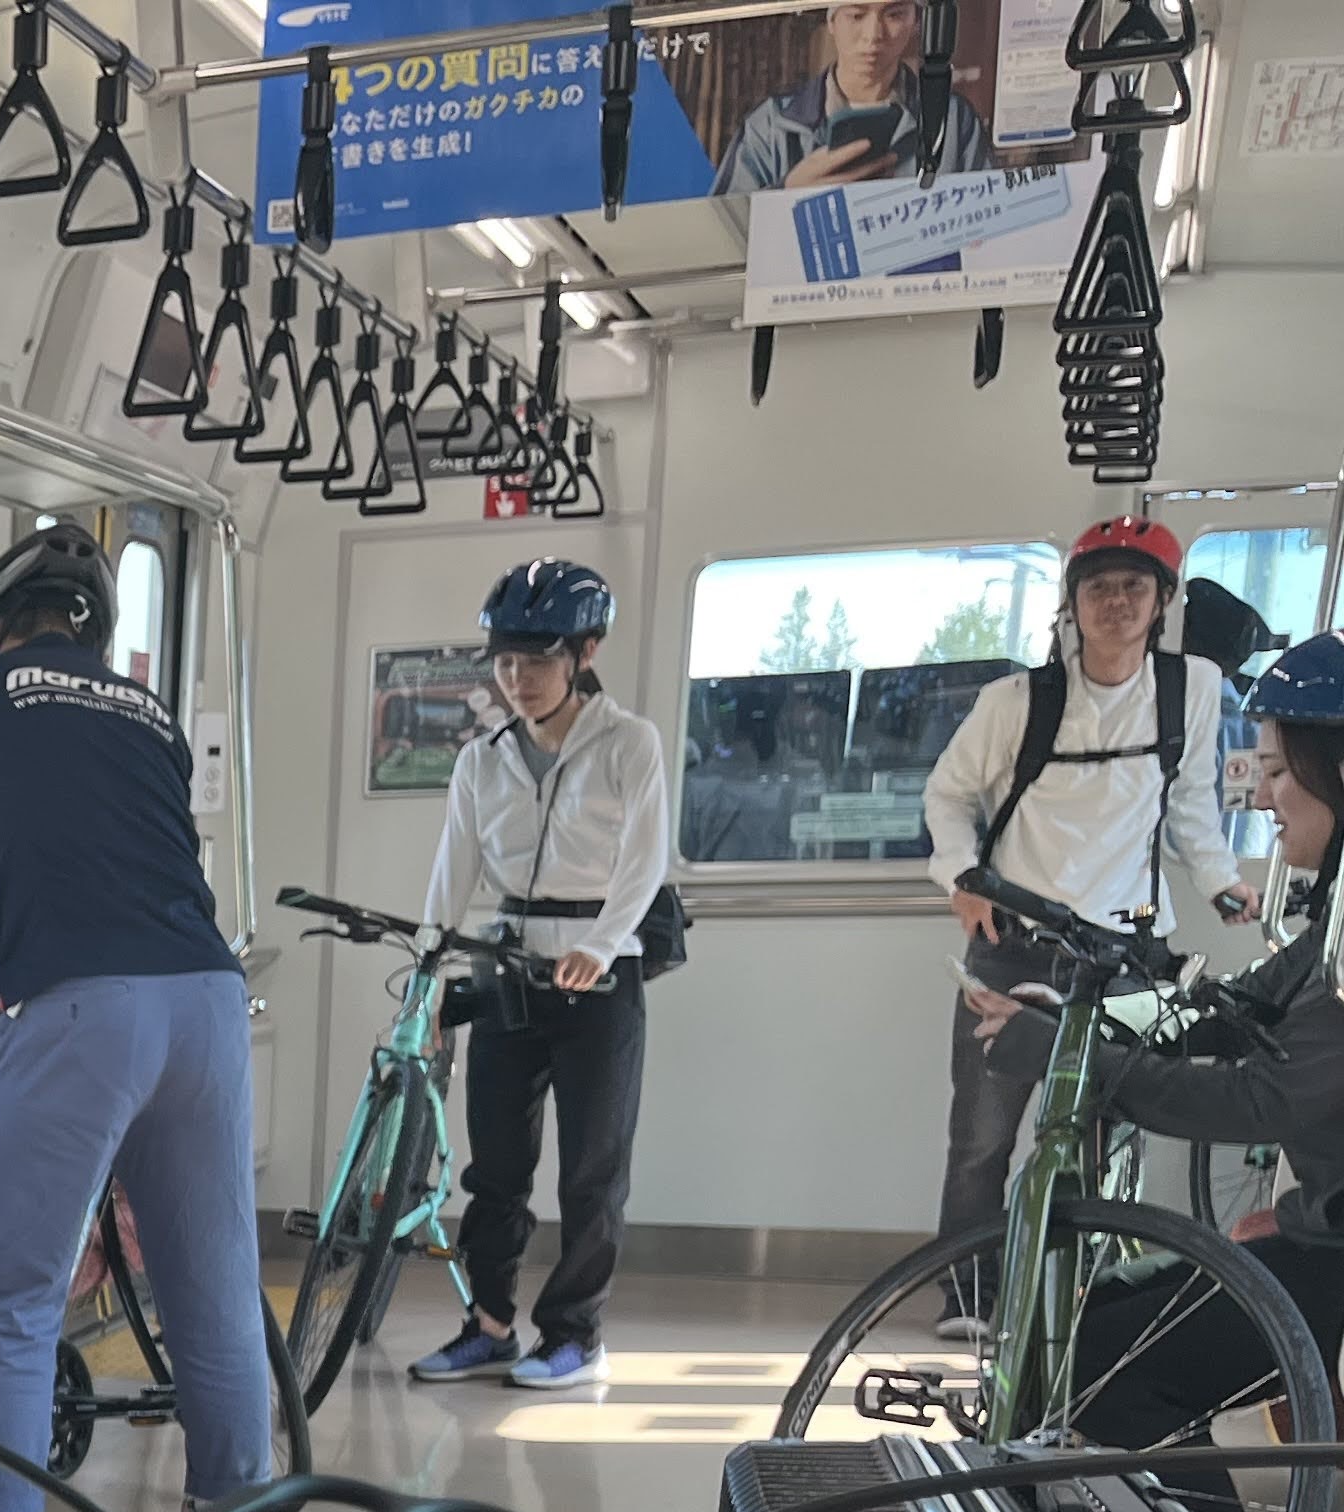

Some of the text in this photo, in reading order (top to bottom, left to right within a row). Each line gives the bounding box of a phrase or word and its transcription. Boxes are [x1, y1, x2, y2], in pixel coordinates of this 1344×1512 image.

[331, 131, 472, 170] 書きを生成!
